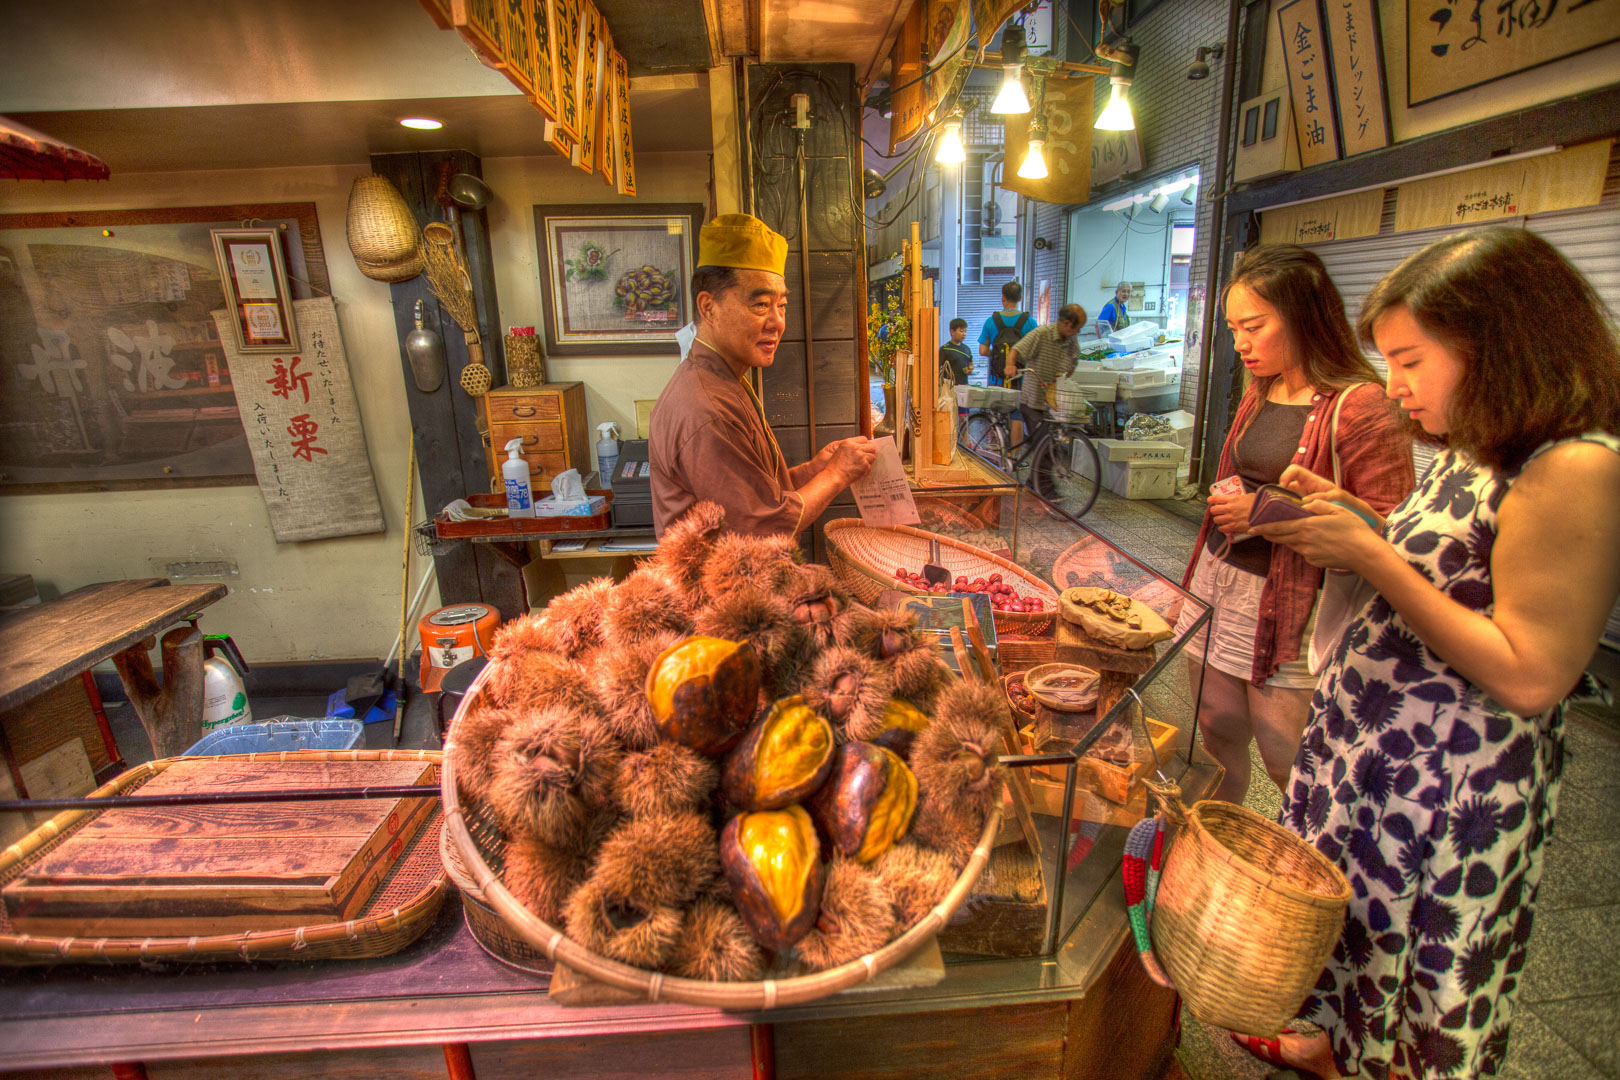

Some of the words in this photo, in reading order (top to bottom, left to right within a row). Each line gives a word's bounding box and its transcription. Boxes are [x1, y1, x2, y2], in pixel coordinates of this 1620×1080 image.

[616, 59, 634, 188] 特殊圧力製法
[1293, 22, 1325, 149] 金ごま油
[266, 356, 329, 462] 新栗
[312, 330, 341, 424] お待たせいたしました
